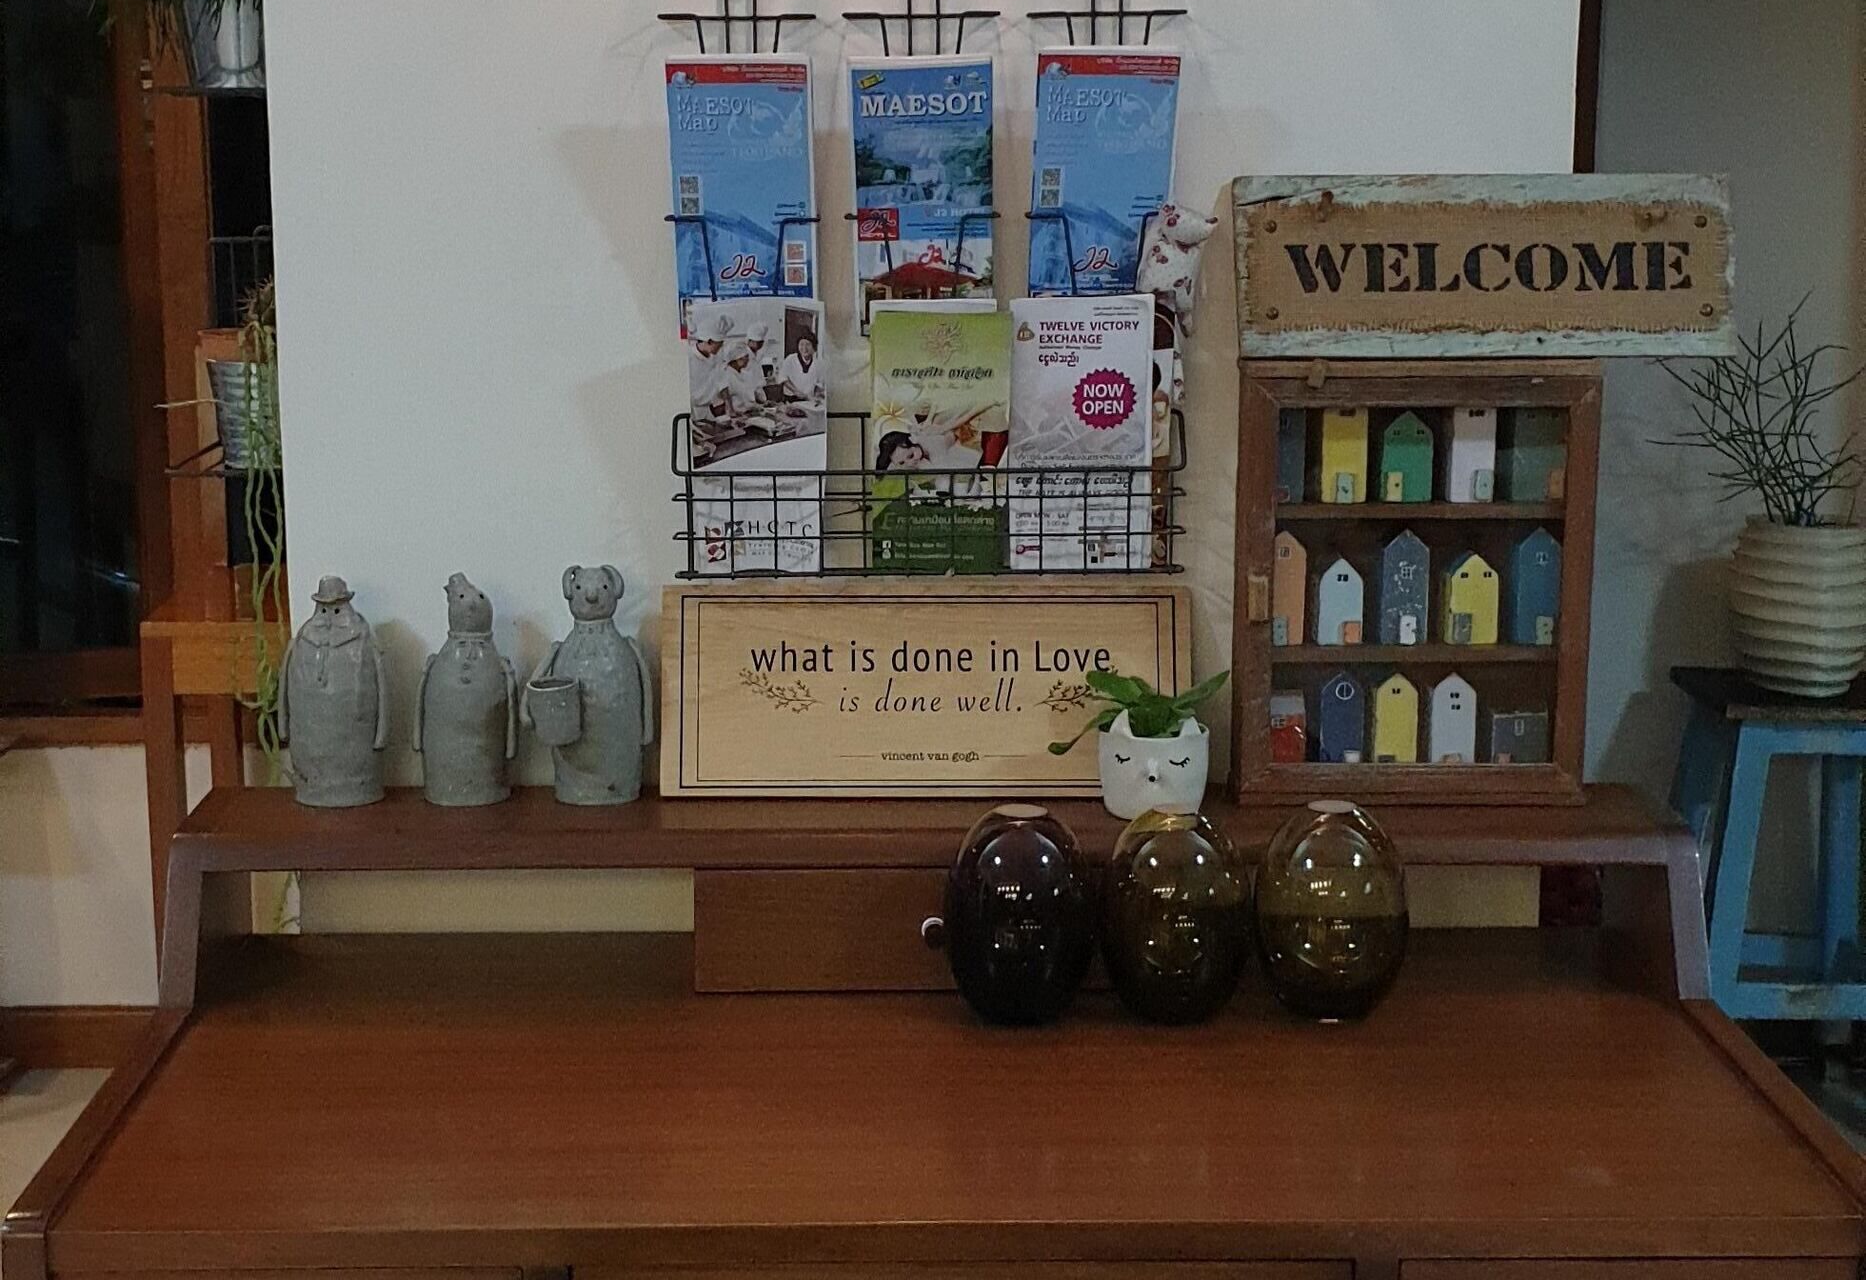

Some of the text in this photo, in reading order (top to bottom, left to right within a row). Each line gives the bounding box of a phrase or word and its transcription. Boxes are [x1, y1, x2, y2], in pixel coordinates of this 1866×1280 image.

[860, 91, 988, 117] MAESOT
[1284, 241, 1694, 294] WELCOME
[1039, 320, 1140, 331] TWELVE VICTORY
[1039, 334, 1103, 344] EXCHANGE
[1083, 383, 1125, 398] NOW
[1082, 400, 1124, 415] OPEN
[751, 640, 1111, 672] what is done in Love
[839, 677, 1022, 712] is done well.
[881, 752, 925, 761] vincent
[952, 751, 980, 763] gogh
